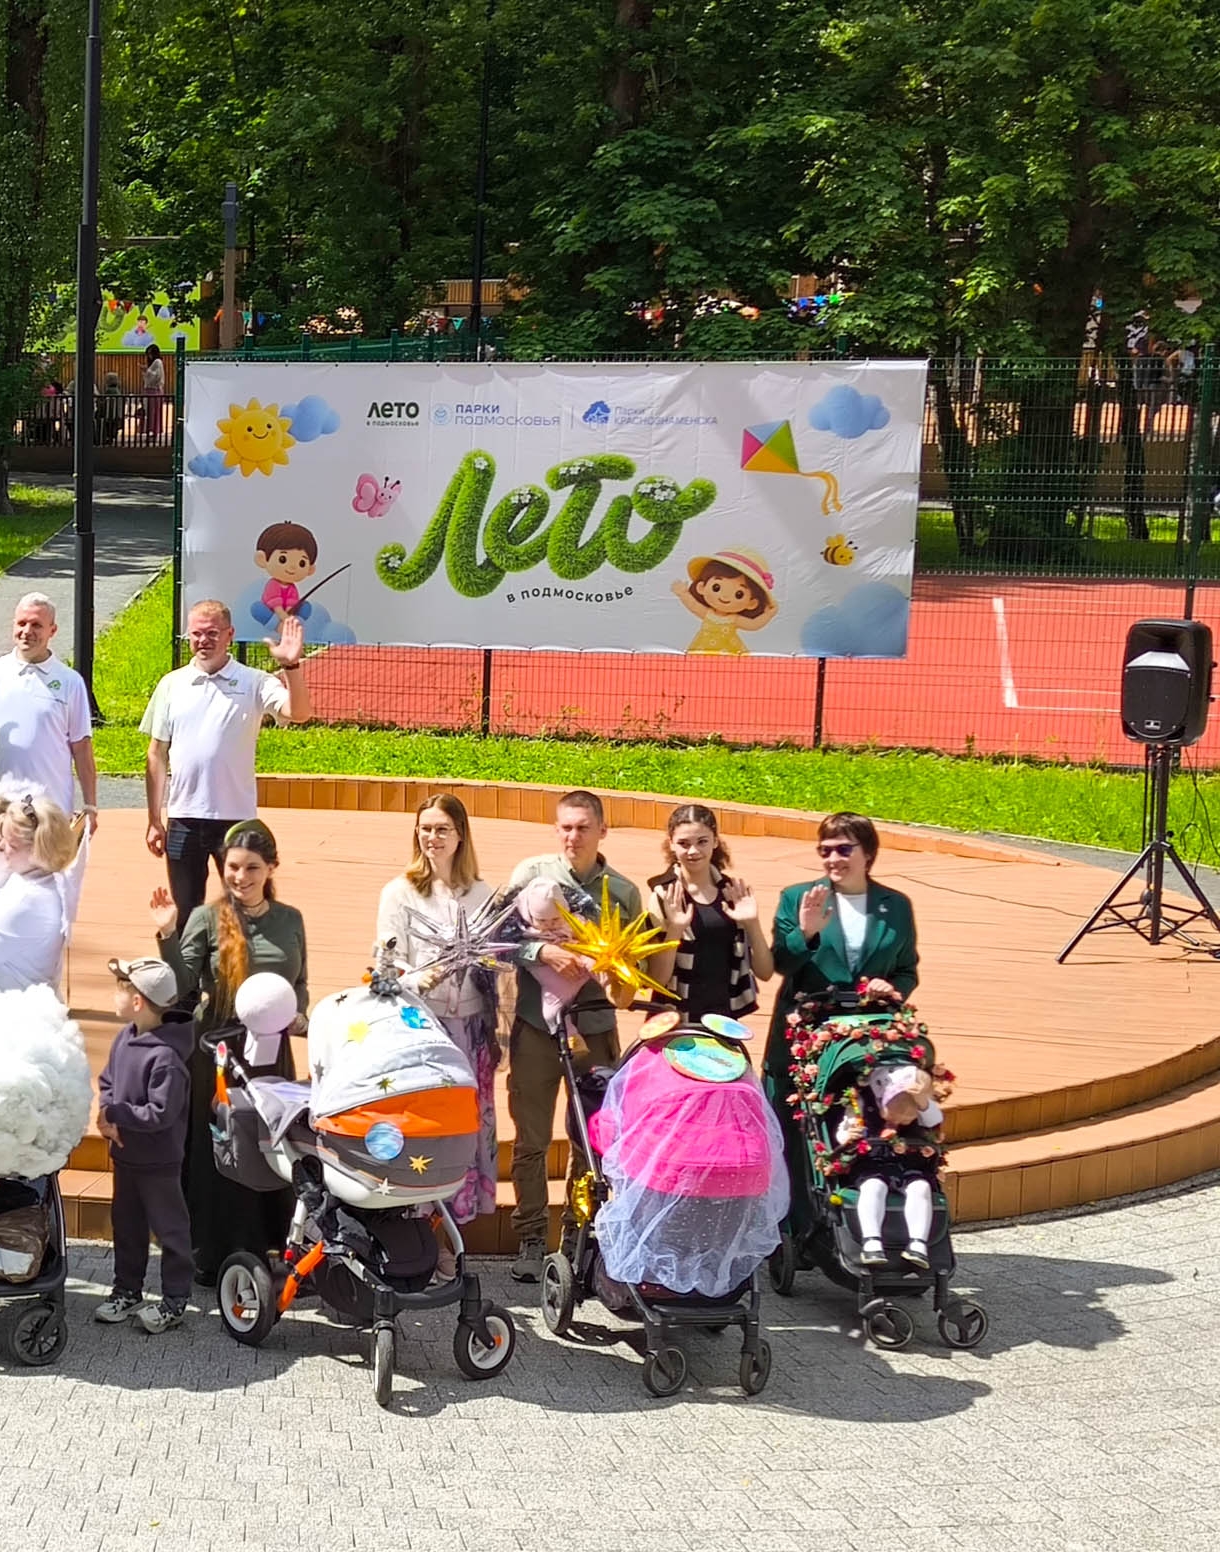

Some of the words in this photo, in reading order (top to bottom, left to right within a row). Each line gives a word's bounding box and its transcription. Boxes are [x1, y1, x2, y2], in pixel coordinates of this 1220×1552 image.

[455, 404, 500, 414] ПАРКИ
[614, 406, 646, 416] Парки
[455, 415, 561, 426] ПОДМОСКОВЬЯ
[614, 416, 718, 425] КРАСНОЗНАМЕНСКА
[375, 448, 717, 598] Лето
[506, 593, 516, 604] в
[520, 585, 634, 603] подмосковье
